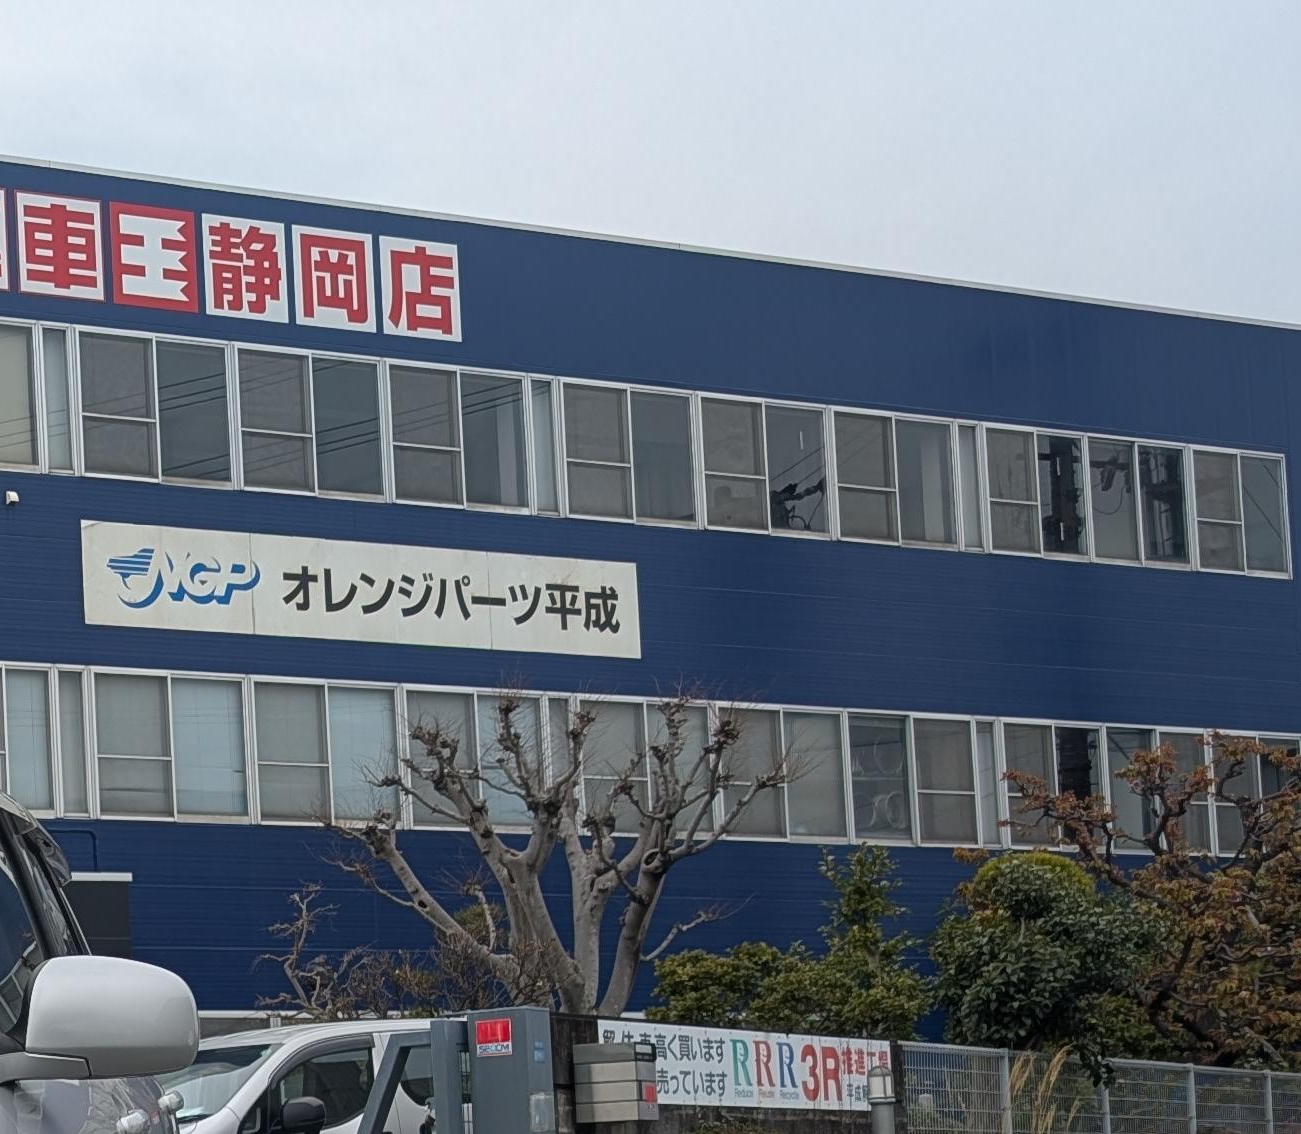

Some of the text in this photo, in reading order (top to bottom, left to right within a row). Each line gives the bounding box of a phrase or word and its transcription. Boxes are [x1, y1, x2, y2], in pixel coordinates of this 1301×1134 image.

[283, 565, 621, 635] オレンジパーツ平成
[801, 1044, 843, 1102] 3R
